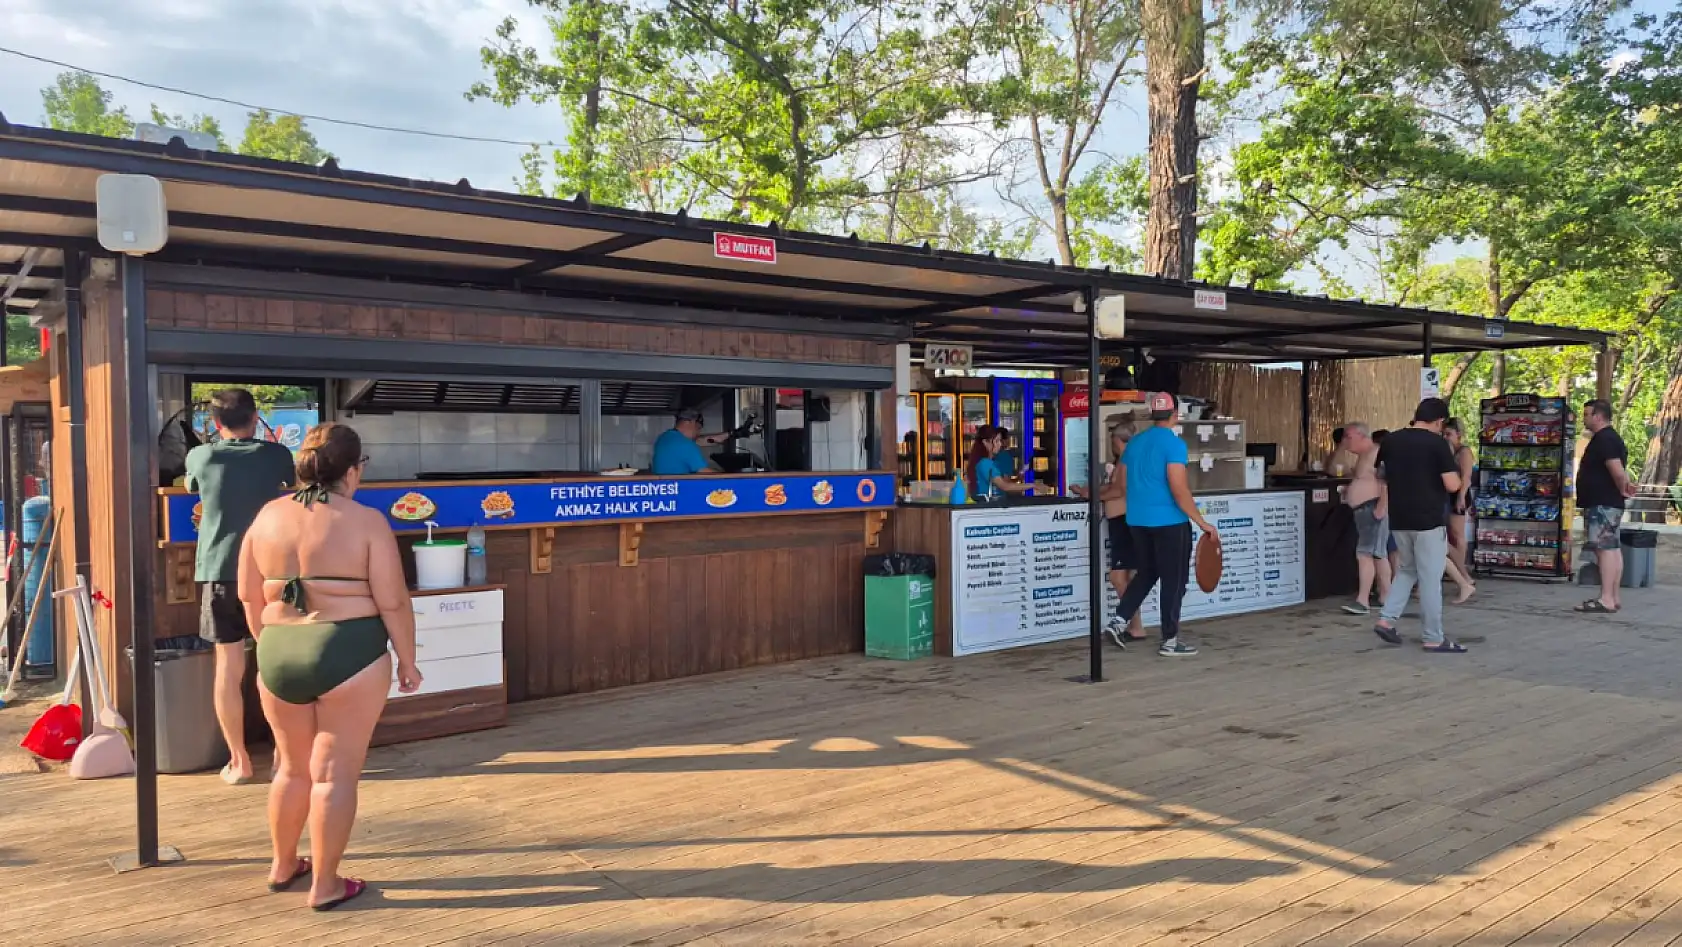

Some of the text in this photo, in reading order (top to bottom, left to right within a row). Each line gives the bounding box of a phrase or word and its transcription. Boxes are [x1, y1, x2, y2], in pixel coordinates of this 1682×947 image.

[733, 242, 772, 256] MUTFAK
[550, 481, 679, 500] FETHİYE BELEDİYESİ
[555, 500, 676, 517] AKMAZ HALK PLAJI
[1052, 508, 1085, 522] Akmaz
